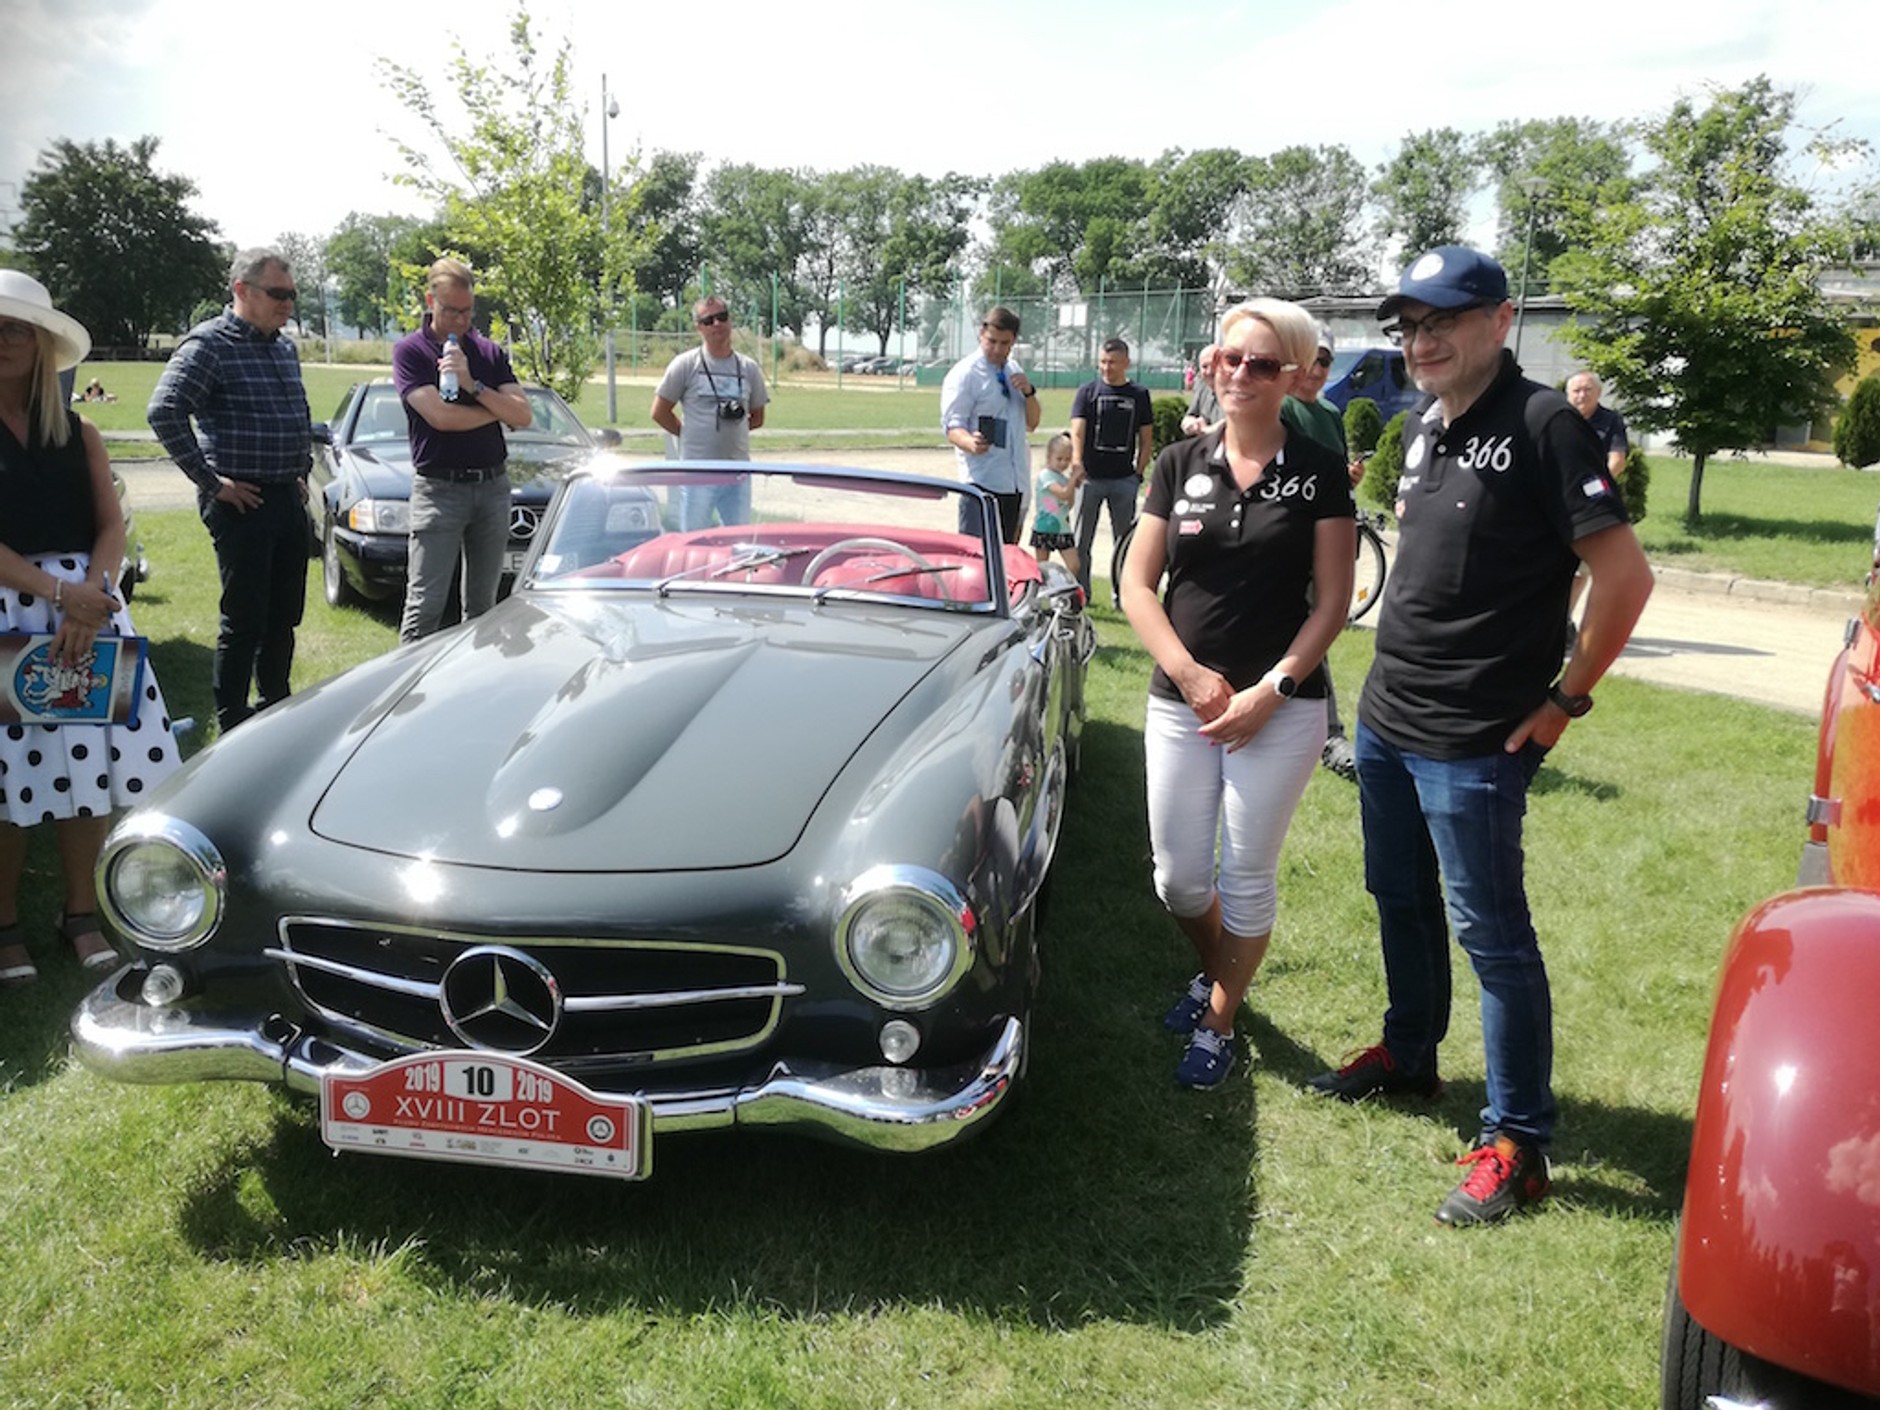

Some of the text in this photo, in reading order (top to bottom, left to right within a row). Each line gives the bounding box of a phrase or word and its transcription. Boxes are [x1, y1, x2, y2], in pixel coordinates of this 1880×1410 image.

[1457, 436, 1512, 471] 366
[1260, 474, 1317, 500] 366
[404, 1062, 553, 1103] 2019 10 2019
[395, 1096, 464, 1122] XVIII
[478, 1103, 561, 1131] ZLOT
